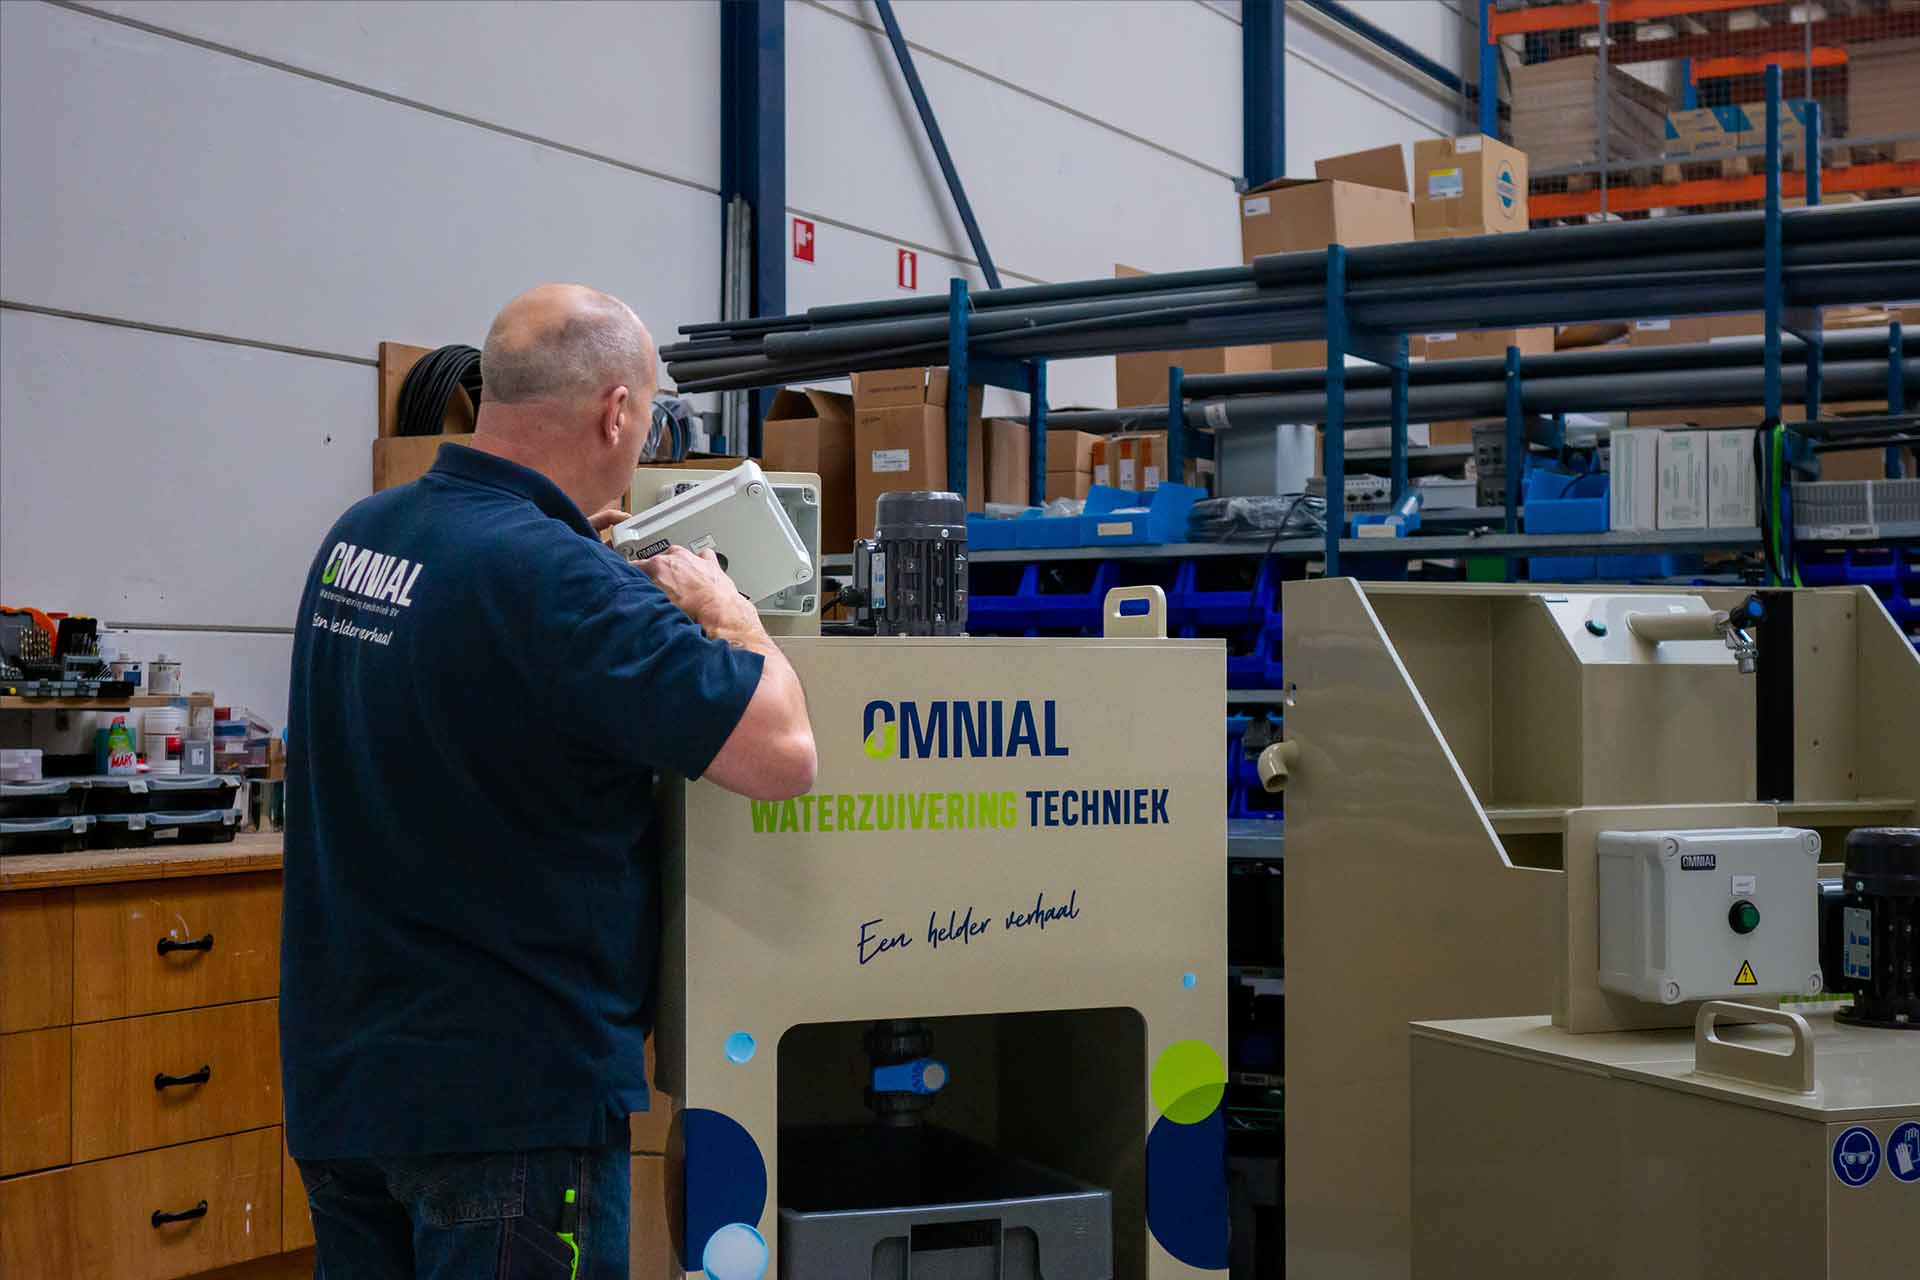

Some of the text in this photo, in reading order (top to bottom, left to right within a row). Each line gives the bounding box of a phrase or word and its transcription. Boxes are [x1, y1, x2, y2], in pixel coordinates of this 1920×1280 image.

[321, 542, 424, 607] OMNIAL
[864, 699, 1069, 759] OMNIAL
[751, 788, 1170, 833] WATERZUIVERING TECHNIEK
[1682, 856, 1715, 867] OMNIAL
[858, 889, 1081, 965] Een helder verhaal
